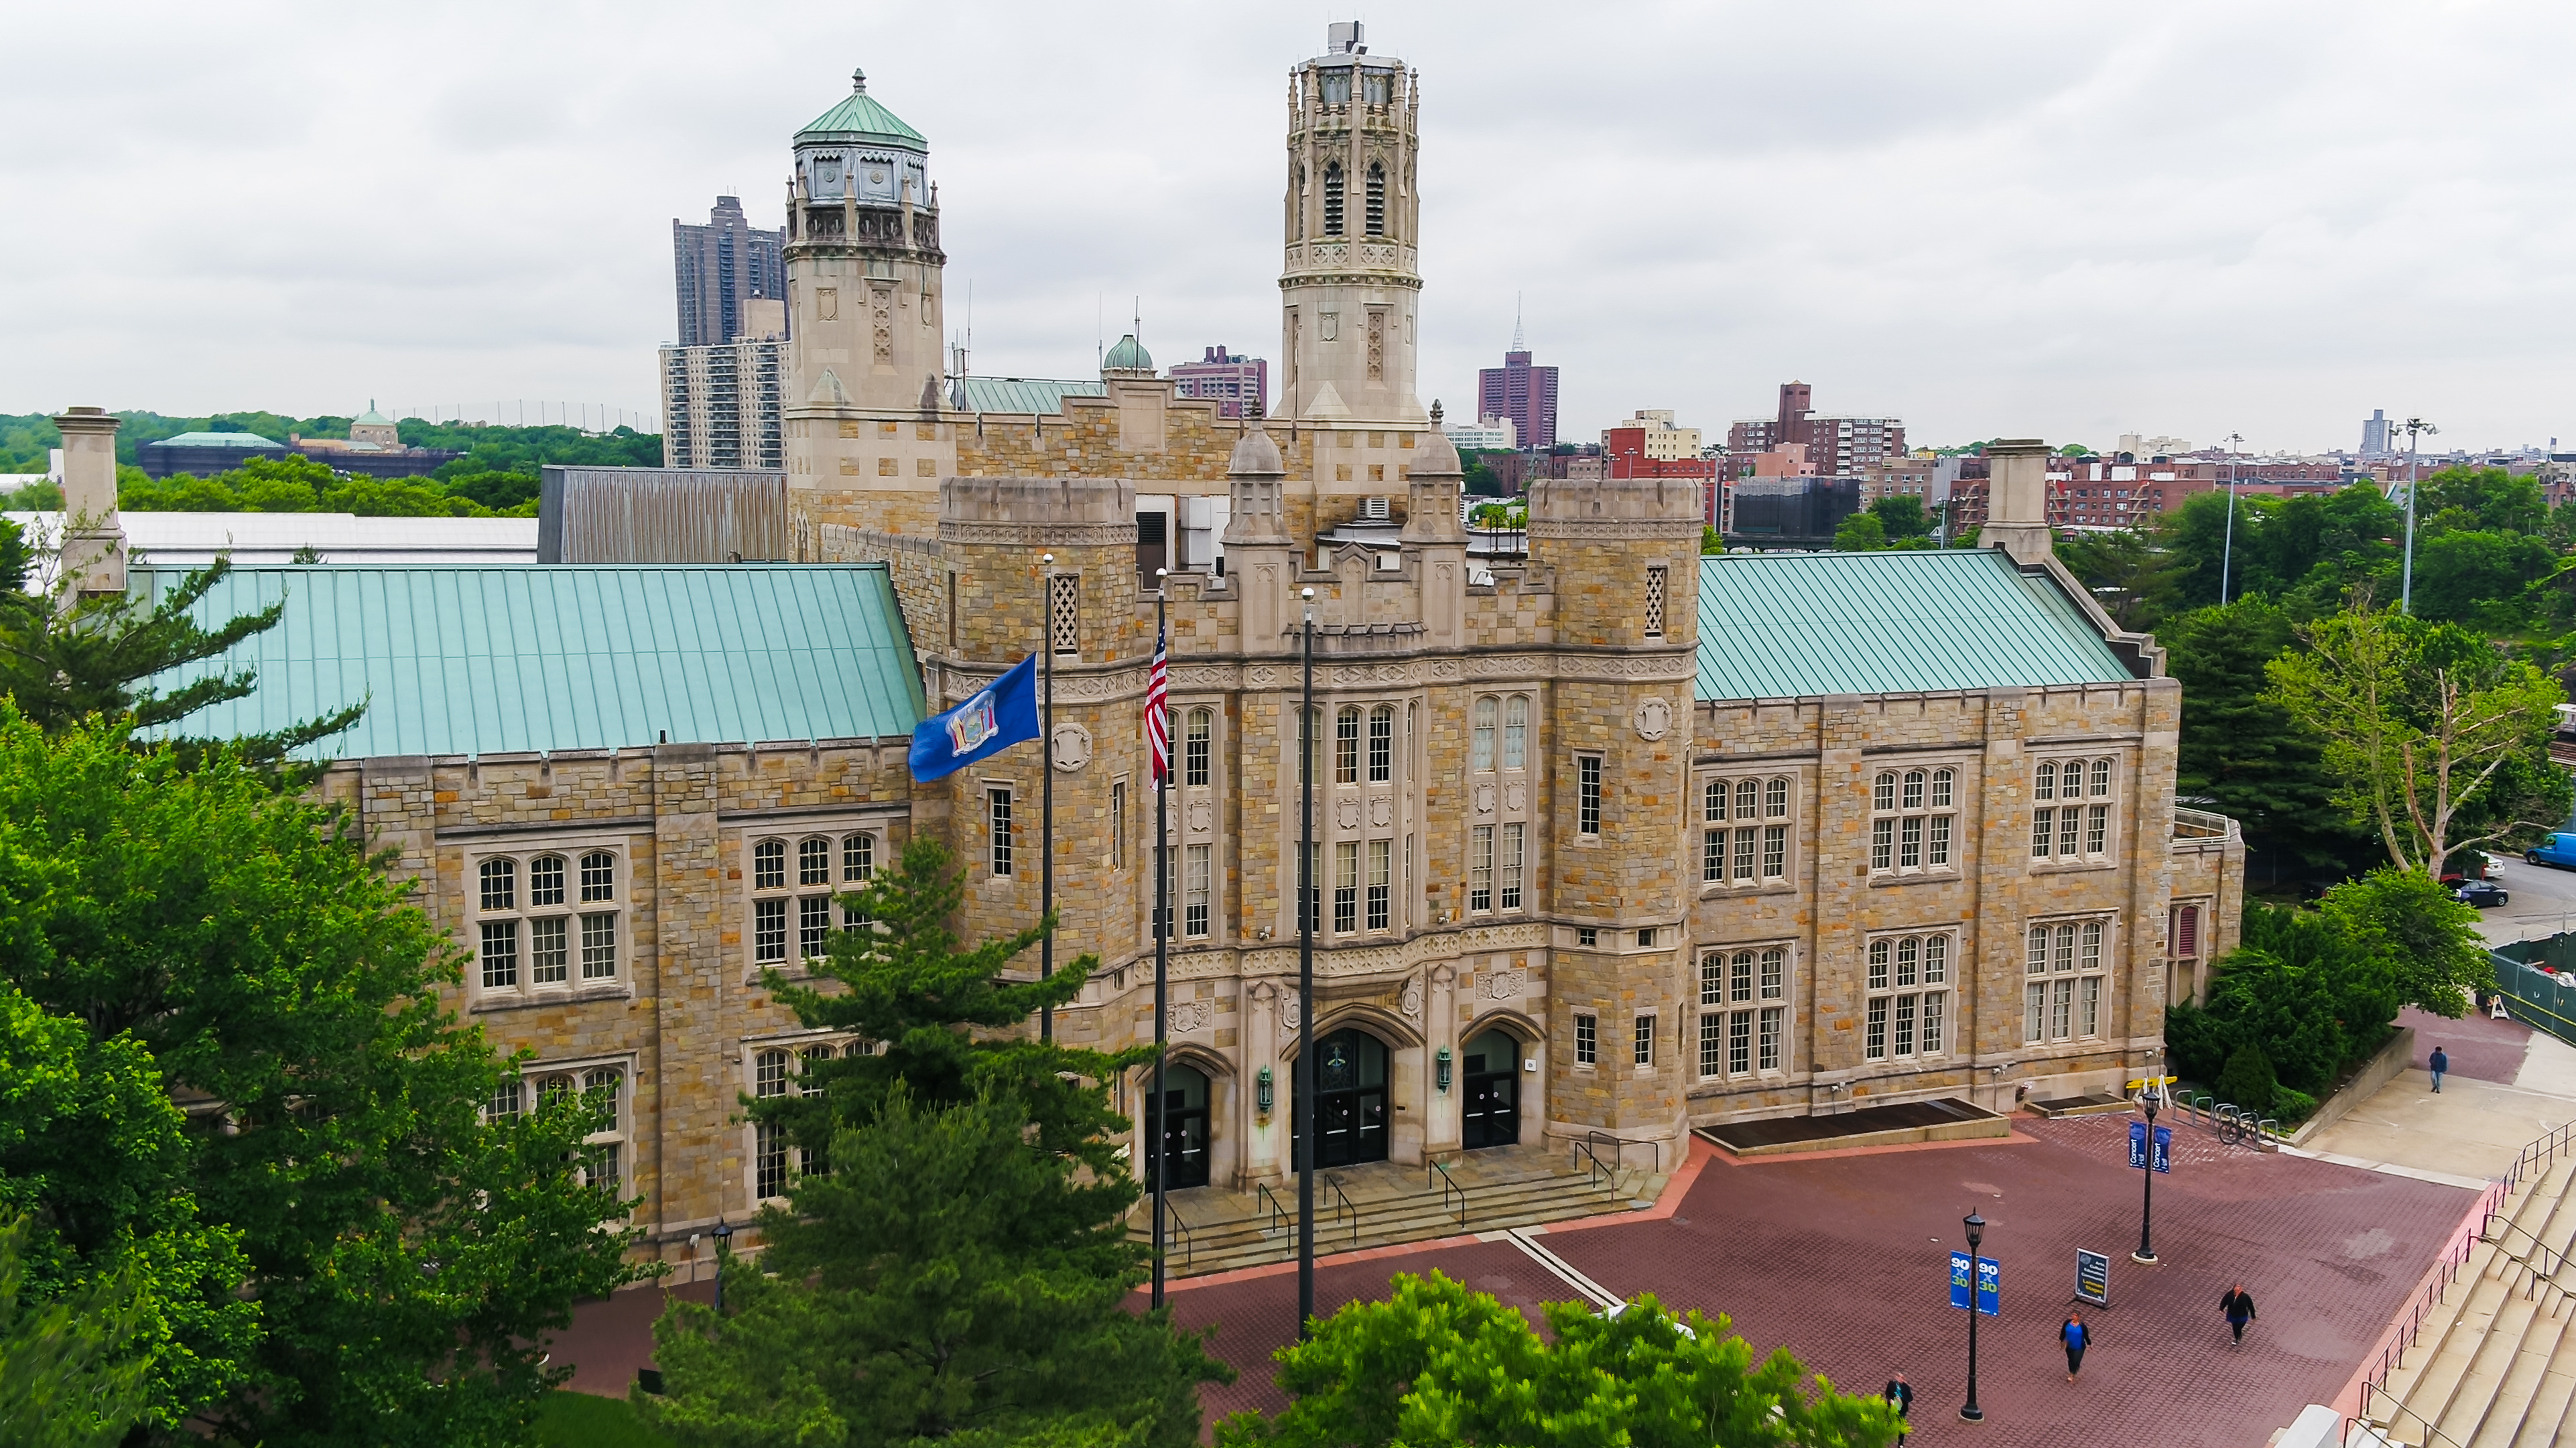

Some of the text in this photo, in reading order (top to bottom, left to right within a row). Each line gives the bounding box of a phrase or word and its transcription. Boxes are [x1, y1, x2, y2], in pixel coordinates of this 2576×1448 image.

[1951, 1257, 1970, 1270] 90
[1978, 1262, 1998, 1276] 90
[1951, 1274, 1968, 1288] 30
[1979, 1280, 1998, 1293] 30
